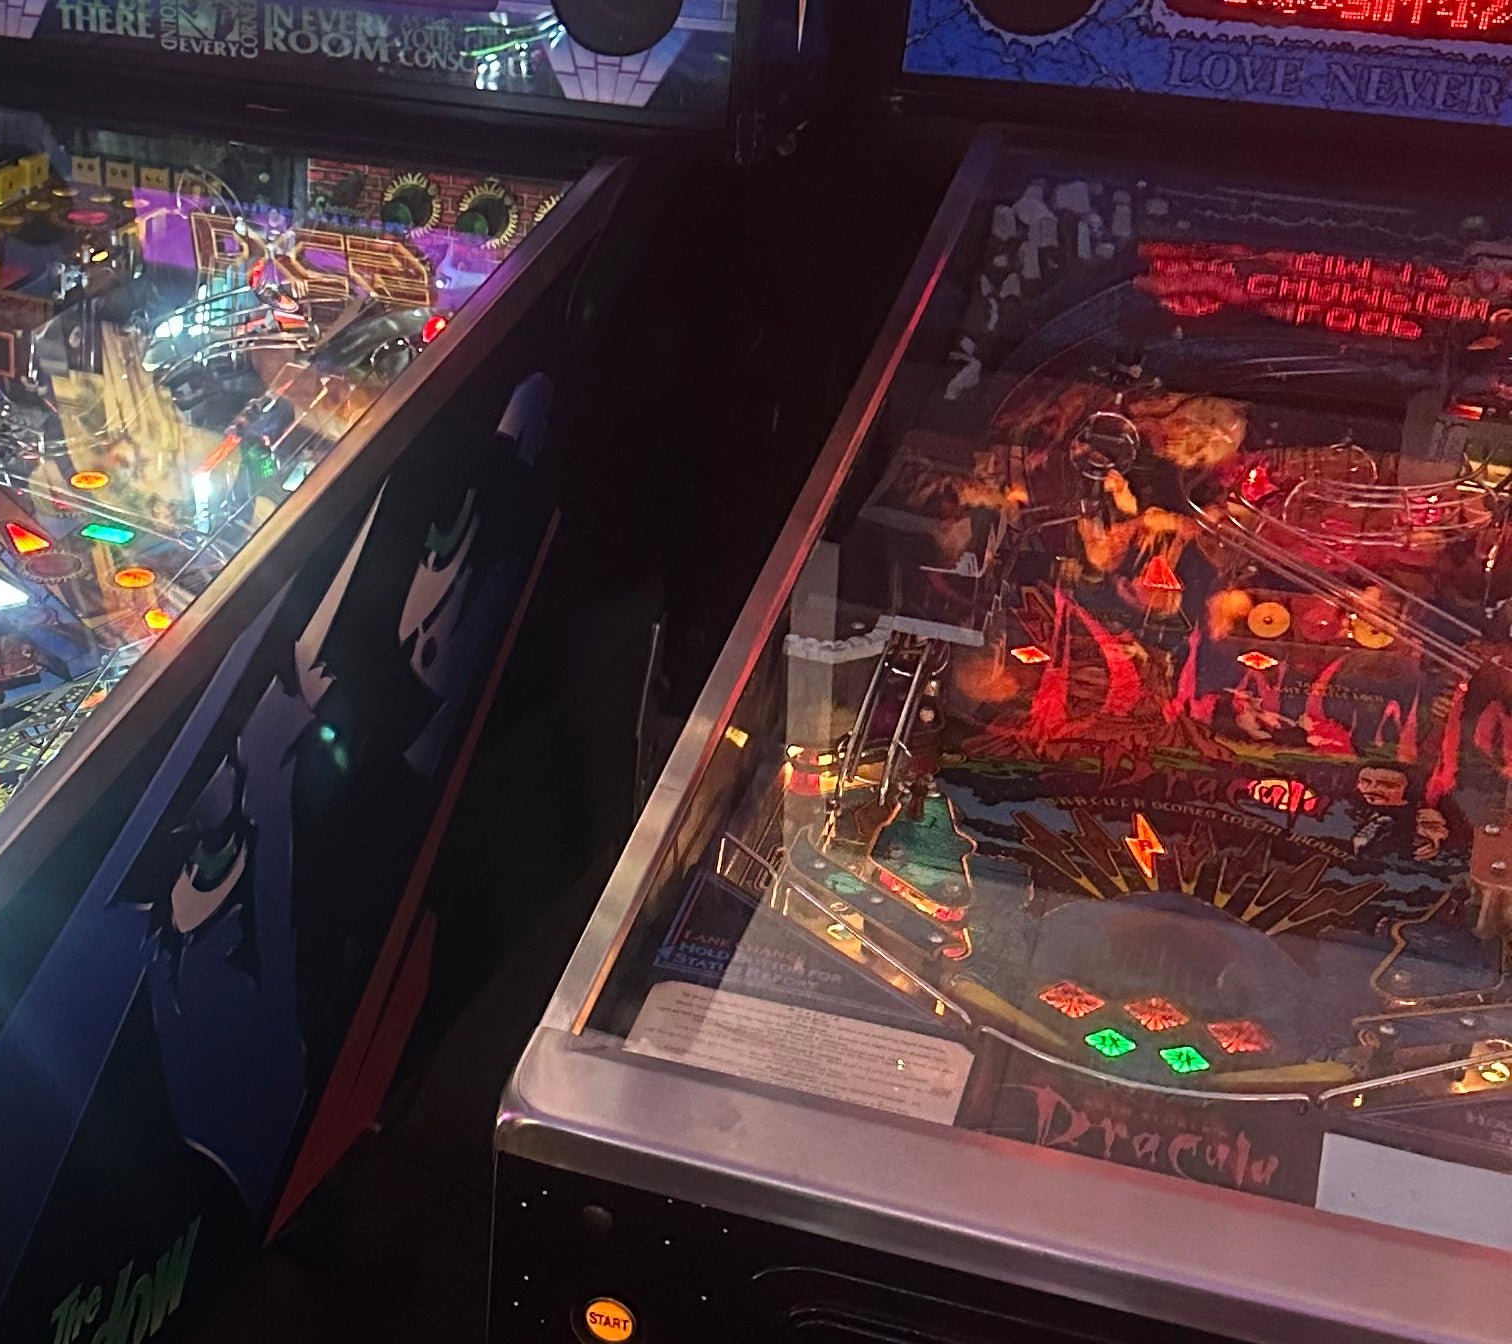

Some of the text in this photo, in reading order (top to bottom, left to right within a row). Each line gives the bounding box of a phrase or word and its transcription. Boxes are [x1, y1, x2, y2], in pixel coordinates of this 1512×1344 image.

[59, 4, 155, 39] THERE
[264, 3, 291, 31] IN
[297, 6, 391, 38] EVERY
[179, 38, 241, 58] EVERY
[264, 27, 391, 63] ROOM
[400, 27, 456, 52] YOUR
[1168, 46, 1502, 117] LOVE NEVER
[1018, 1085, 1280, 1186] Dracula
[589, 1311, 630, 1332] START
